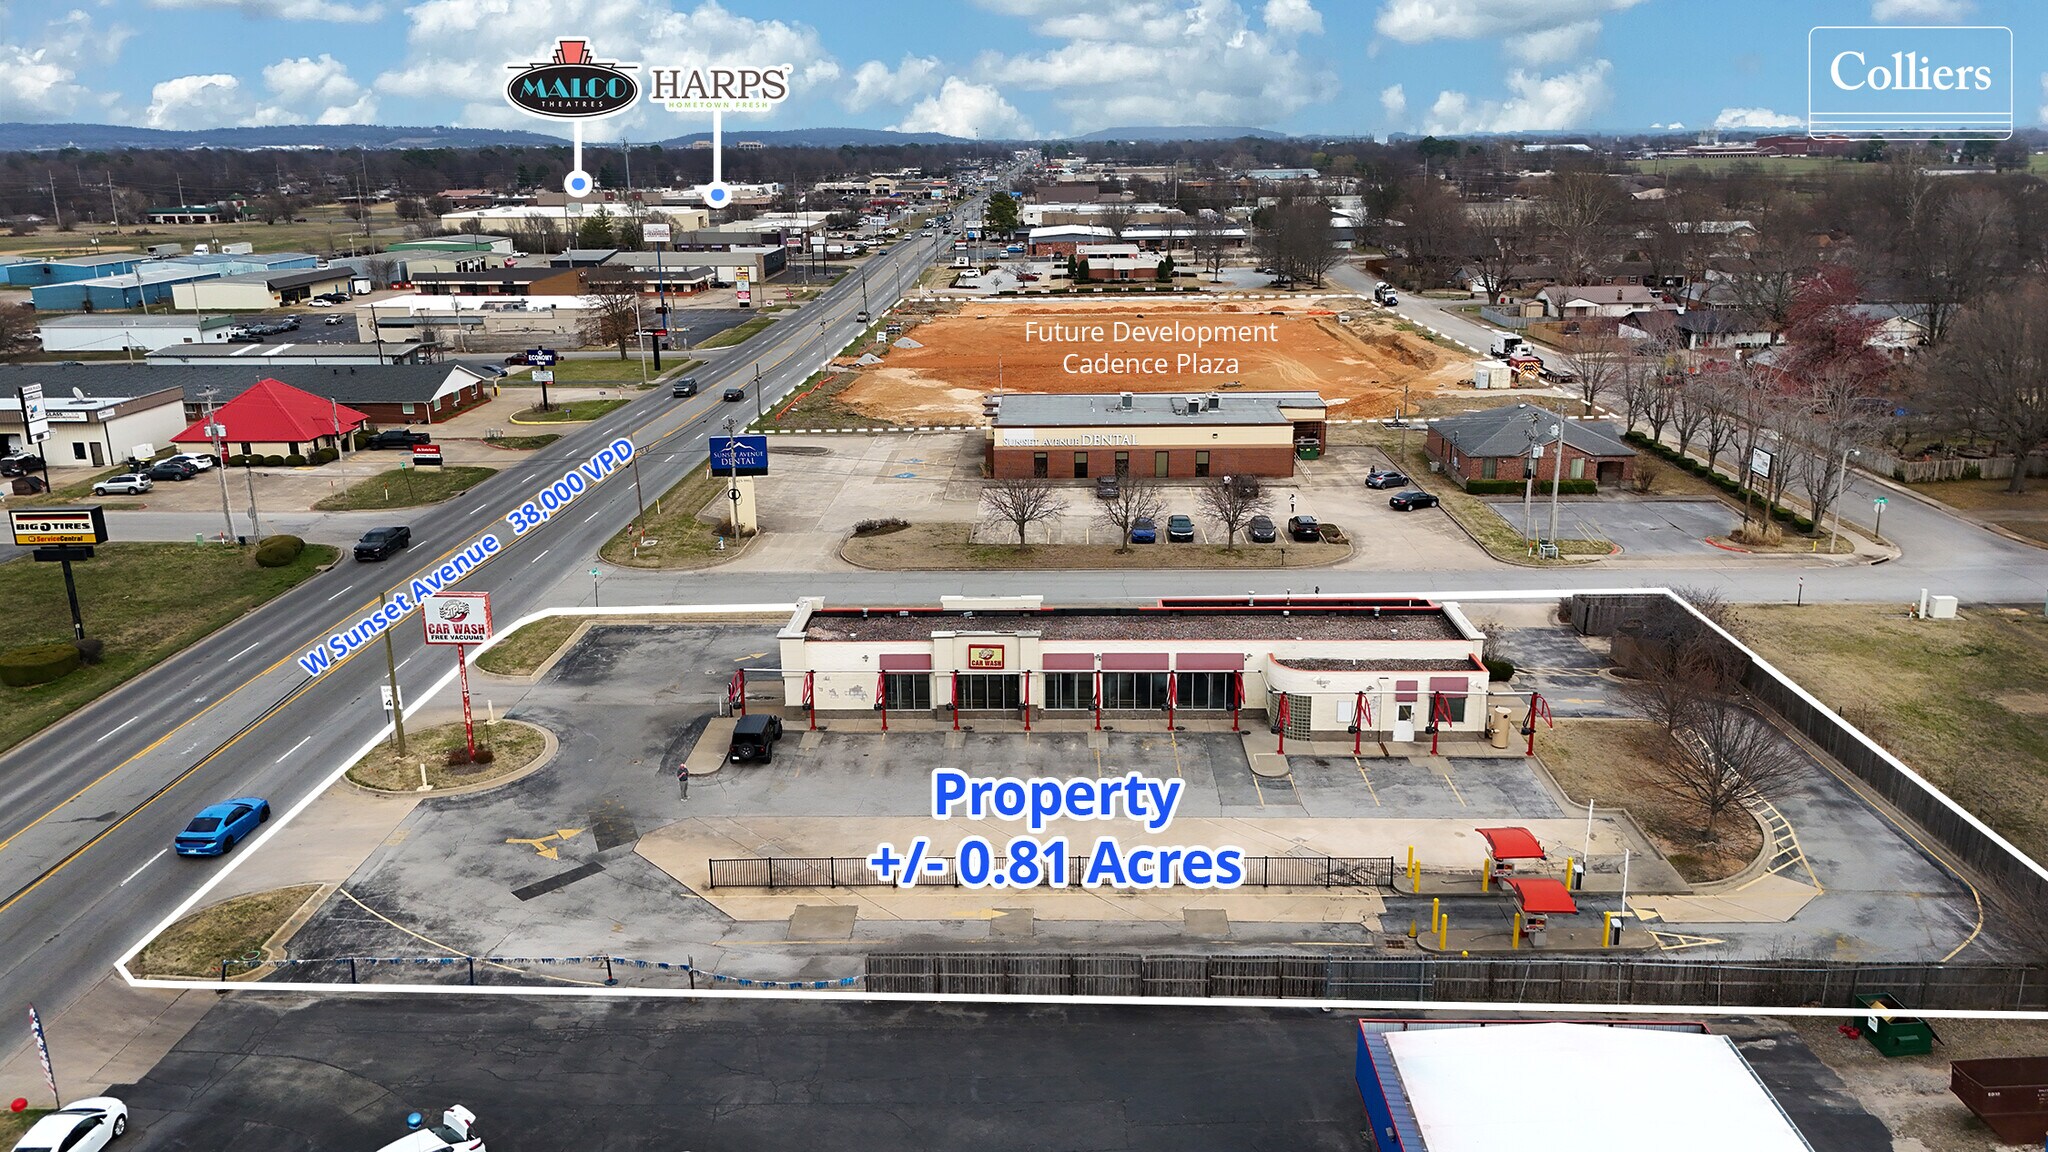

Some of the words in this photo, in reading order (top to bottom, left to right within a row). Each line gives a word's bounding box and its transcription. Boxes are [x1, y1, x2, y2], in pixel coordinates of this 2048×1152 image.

[1042, 438, 1079, 447] AVENUE
[1081, 434, 1139, 447] DENTAL
[713, 451, 737, 459] SUNST
[16, 523, 39, 531] BIG
[52, 522, 90, 530] TIRES
[428, 623, 450, 635] CAR
[453, 623, 486, 635] WASH
